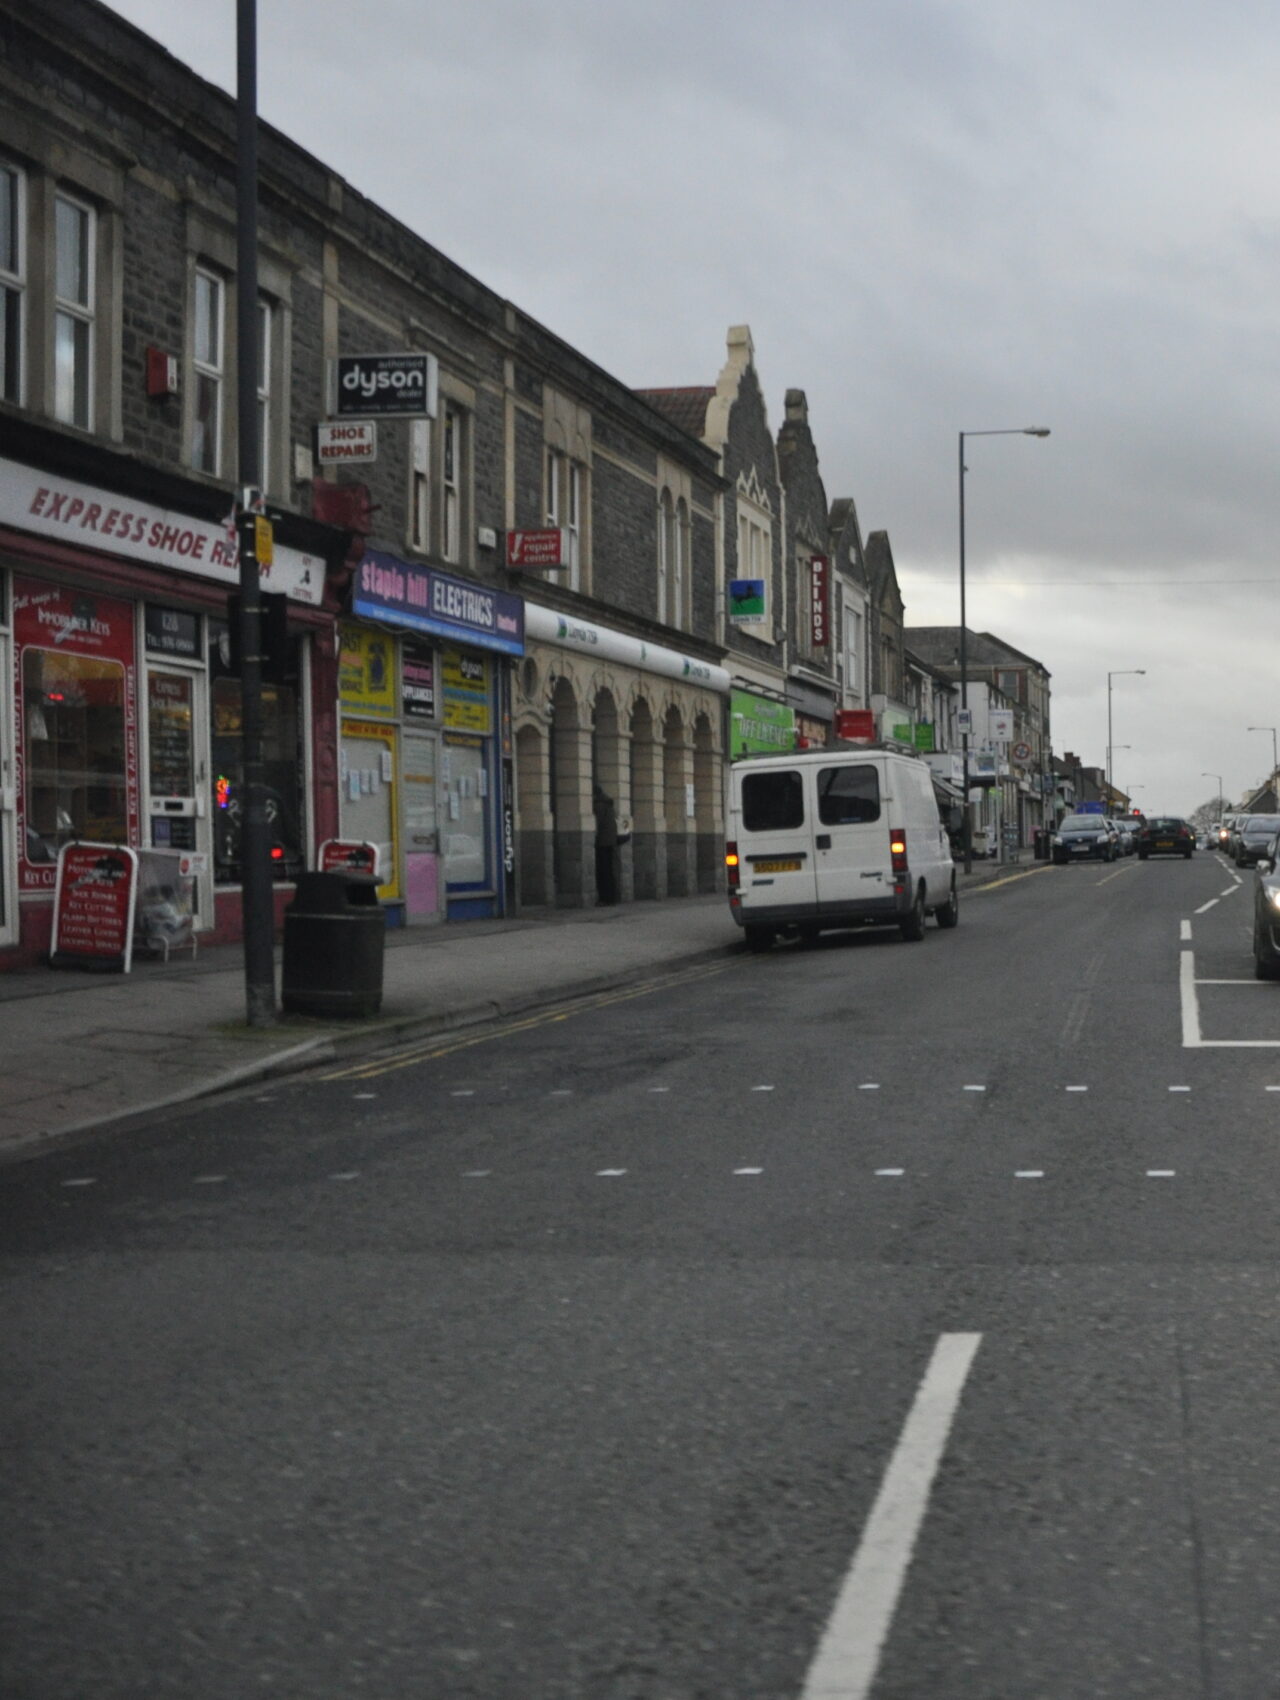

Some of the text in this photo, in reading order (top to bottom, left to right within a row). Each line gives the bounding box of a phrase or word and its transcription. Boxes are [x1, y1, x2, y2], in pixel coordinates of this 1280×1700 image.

[342, 363, 424, 397] dyson
[321, 444, 372, 457] REPAIRS
[330, 427, 365, 440] SHOE
[29, 487, 148, 543] EXPRESS
[148, 521, 207, 560] SHOE
[524, 541, 557, 553] repair
[524, 553, 557, 563] centre
[361, 561, 405, 601] staple
[407, 571, 428, 608] hill
[433, 580, 493, 627] ELECTRICS
[812, 561, 824, 641] BLINDS
[504, 810, 513, 872] dyson
